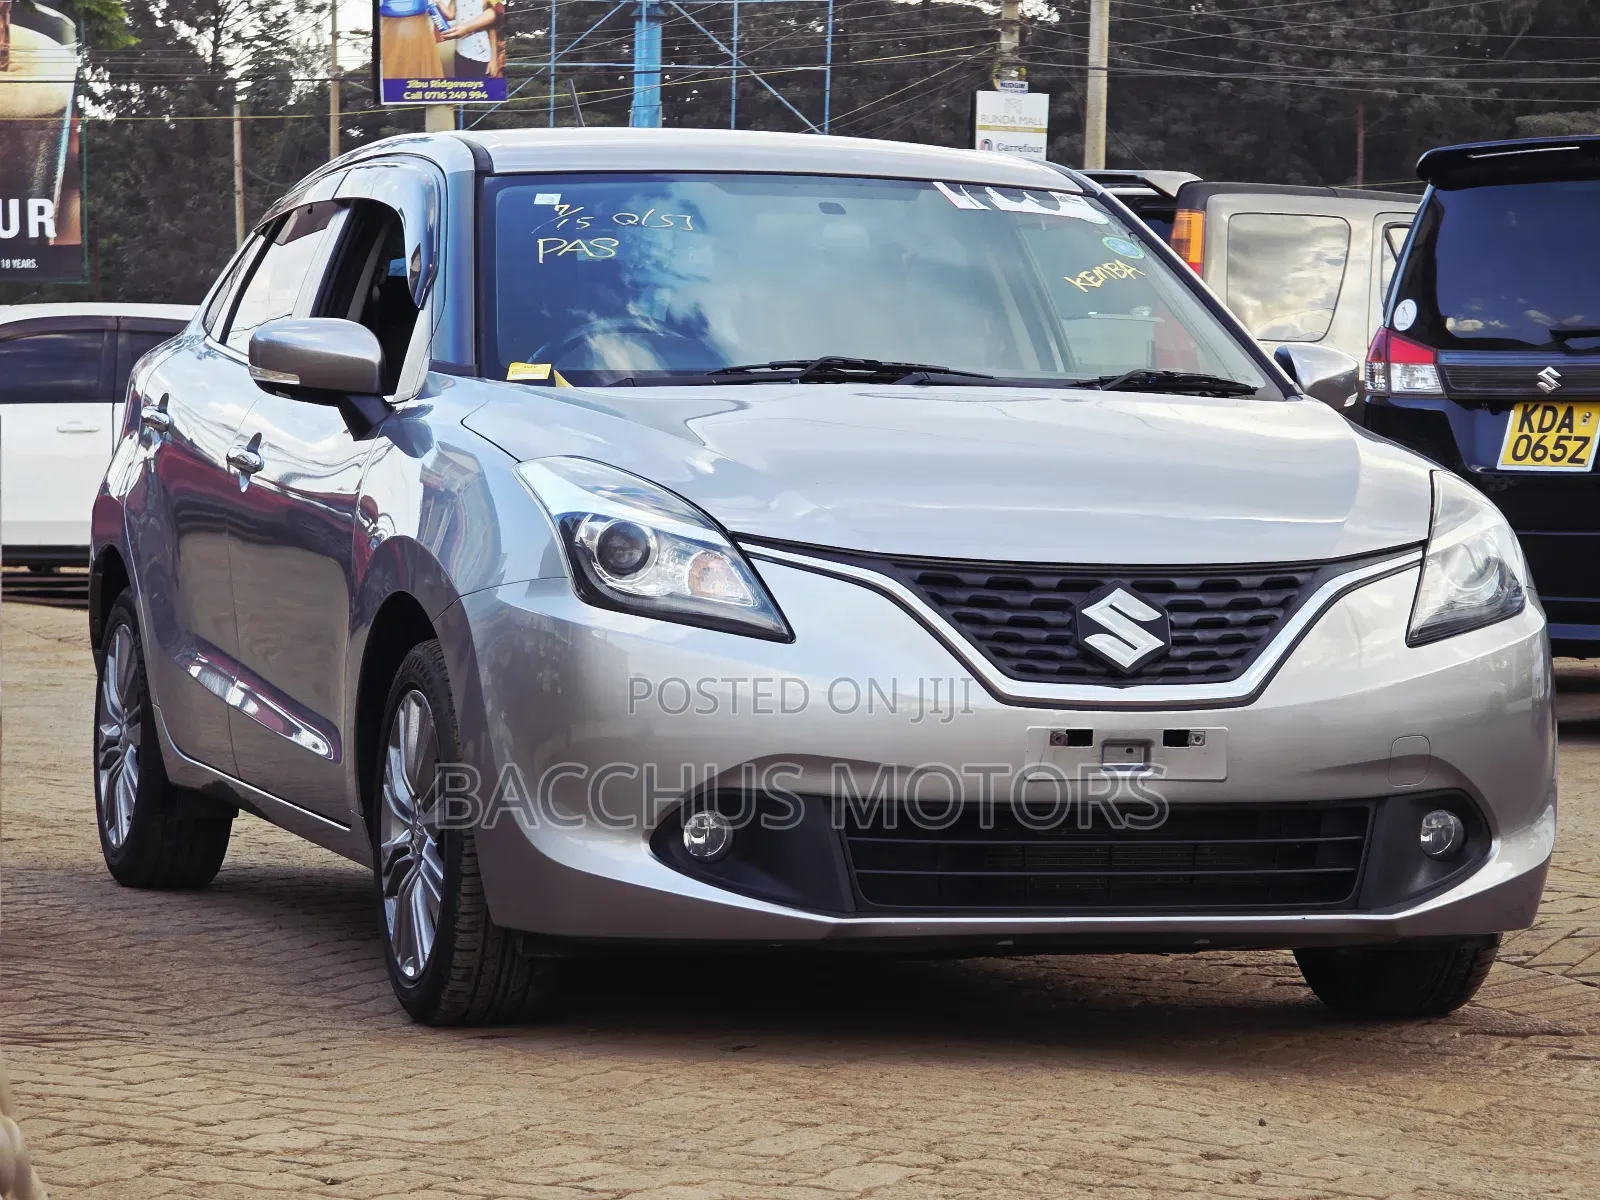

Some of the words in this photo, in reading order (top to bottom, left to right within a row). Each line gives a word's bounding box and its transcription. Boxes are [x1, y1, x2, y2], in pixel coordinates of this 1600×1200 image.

[406, 80, 428, 89] Jibu
[430, 79, 484, 90] Ridgeways
[403, 91, 422, 100] Call
[424, 91, 447, 99] 0716
[448, 91, 467, 99] 249
[468, 90, 488, 99] 994
[980, 114, 1017, 125] RUNDA
[1018, 116, 1044, 126] MALL
[996, 142, 1044, 154] Carrefour
[537, 237, 620, 264] PAS
[1, 258, 11, 269] 18
[1063, 259, 1146, 293] KEMBA
[1517, 403, 1575, 434] KDA
[1511, 434, 1591, 465] 065Z
